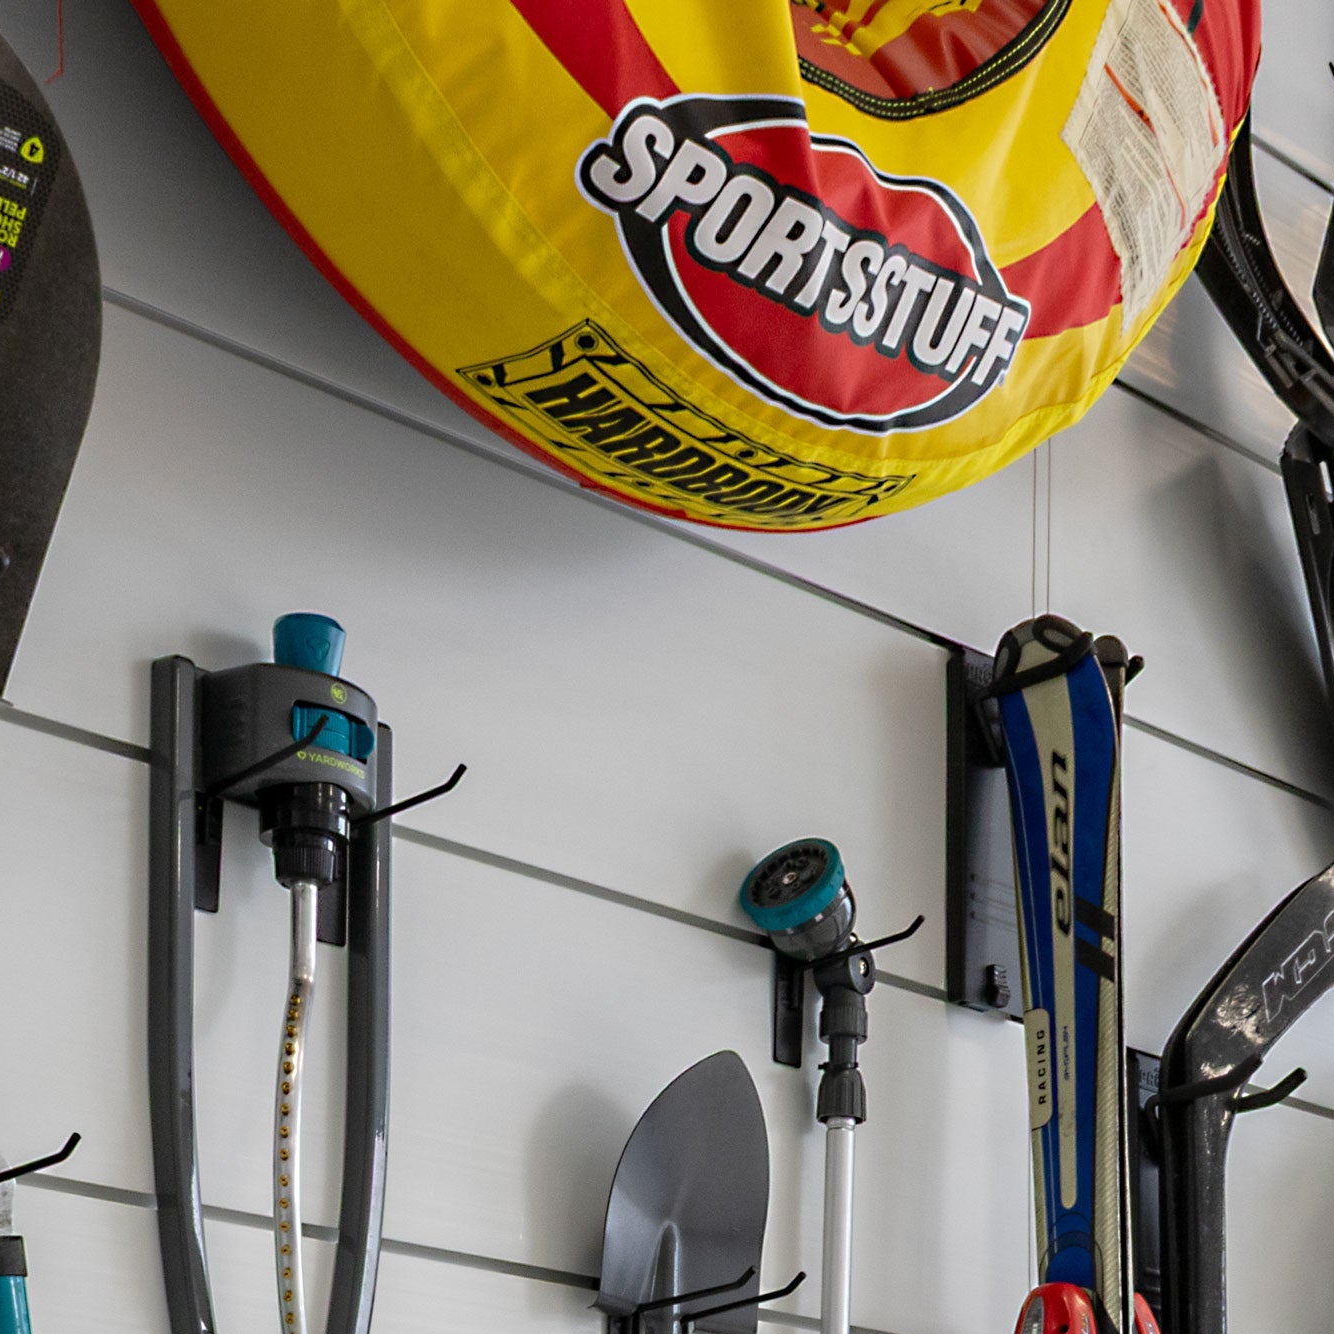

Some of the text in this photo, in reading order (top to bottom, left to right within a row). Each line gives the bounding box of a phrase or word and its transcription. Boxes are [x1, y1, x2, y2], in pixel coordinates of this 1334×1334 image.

[590, 114, 1026, 388] SPORTSSTUFF
[523, 371, 857, 518] HARDBODY
[309, 751, 366, 780] YARDWORKS
[1051, 750, 1073, 938] elan
[1038, 1028, 1047, 1105] RACING
